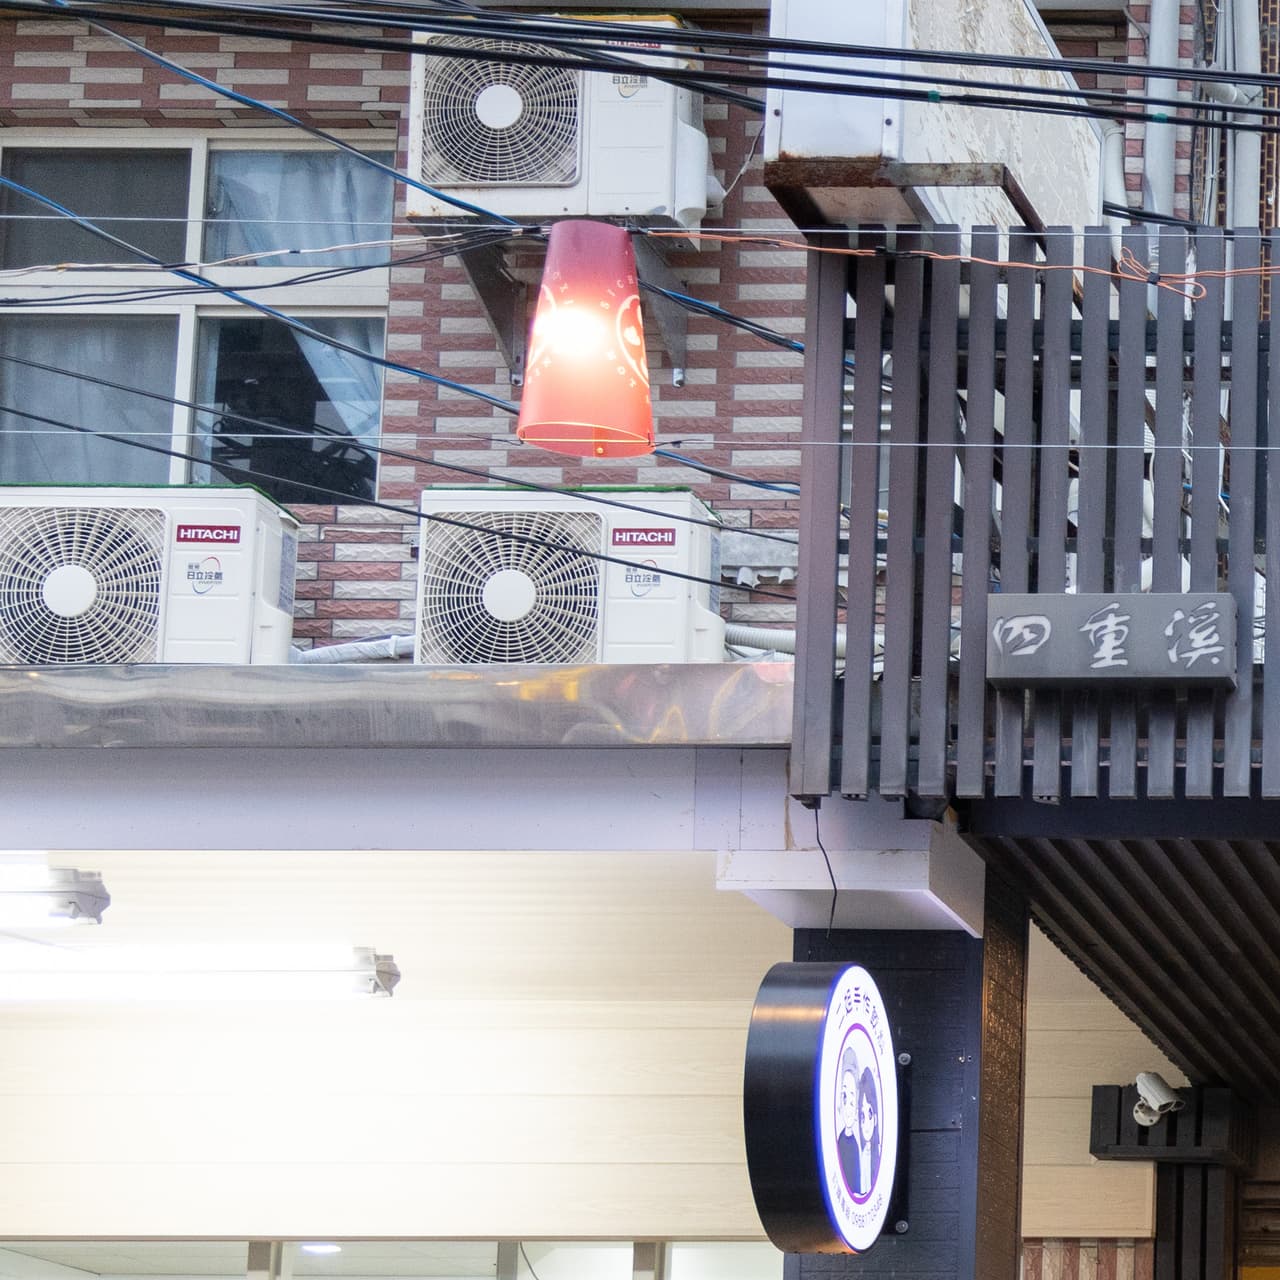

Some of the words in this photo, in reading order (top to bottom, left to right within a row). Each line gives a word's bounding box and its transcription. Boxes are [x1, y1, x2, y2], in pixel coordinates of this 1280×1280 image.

[180, 528, 238, 540] HITACHI
[615, 532, 673, 542] HITACHI
[992, 601, 1227, 669] 四重溪
